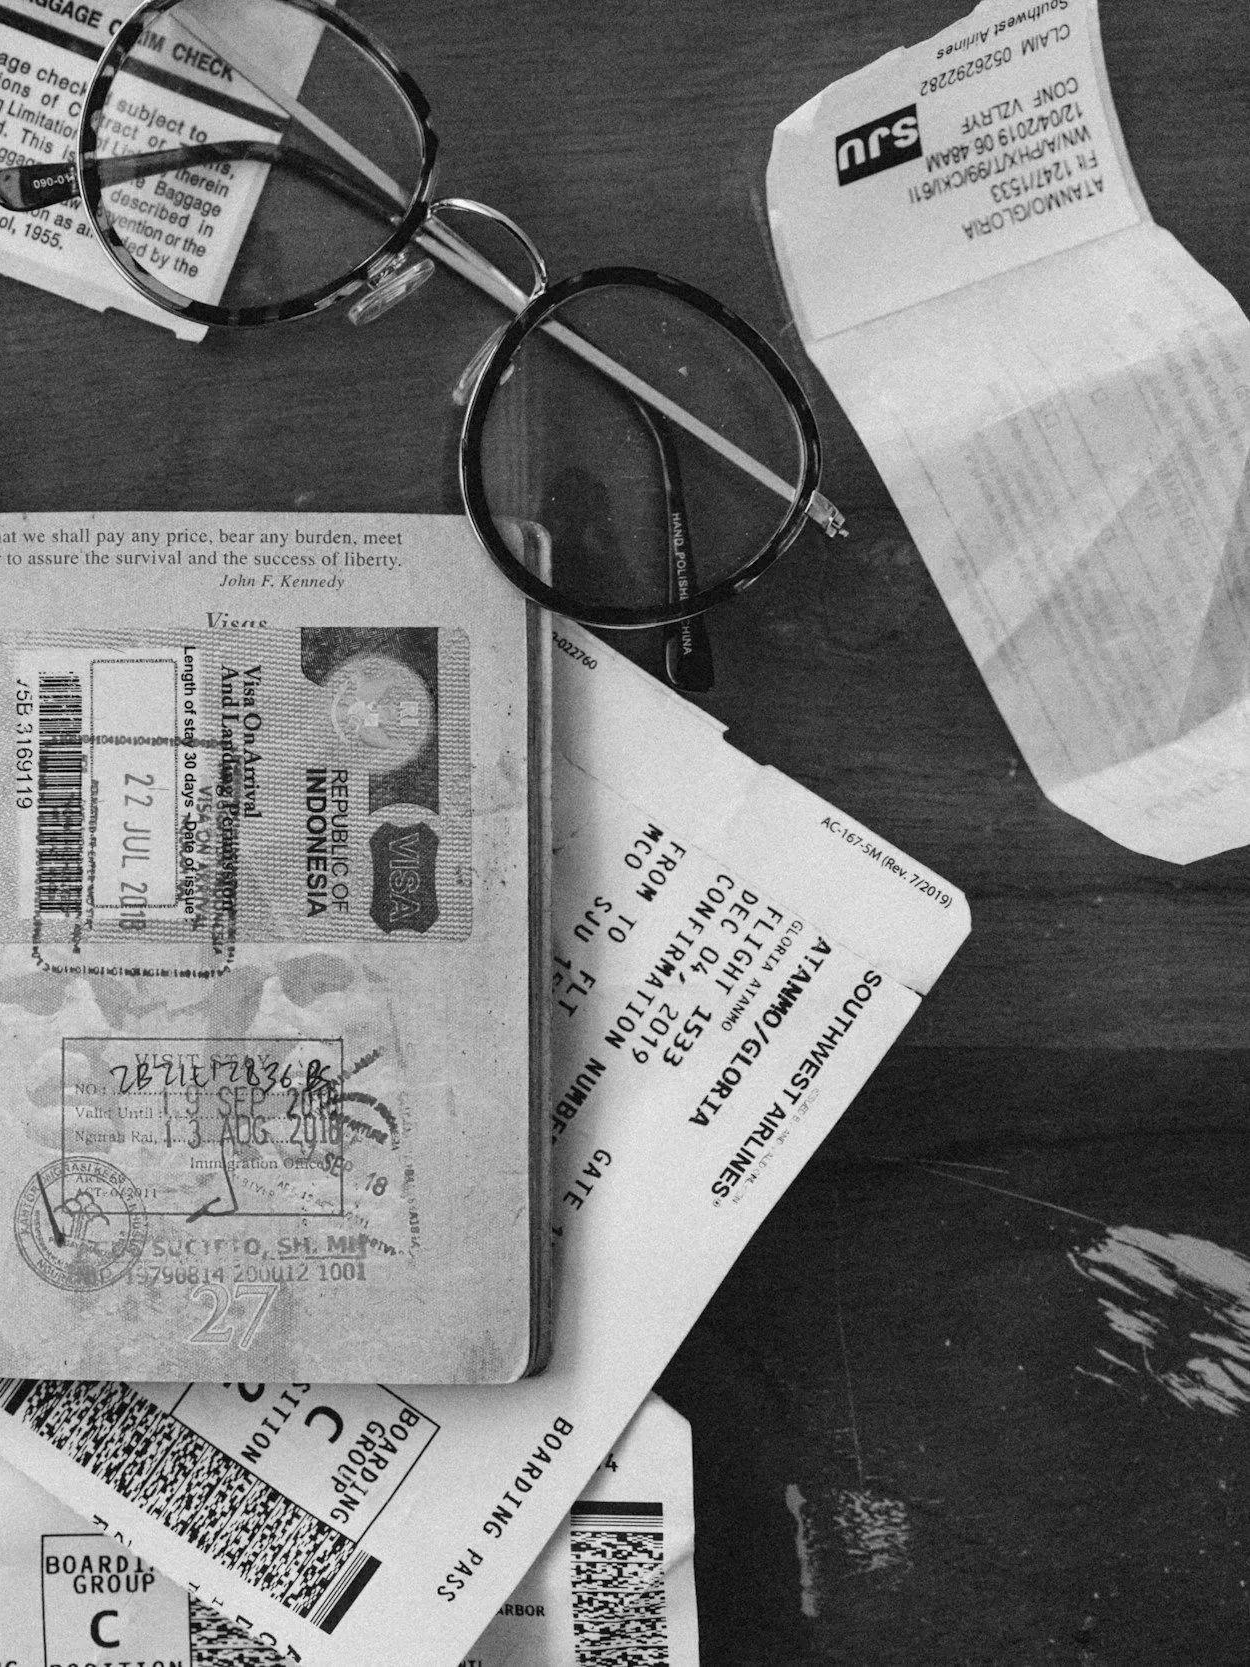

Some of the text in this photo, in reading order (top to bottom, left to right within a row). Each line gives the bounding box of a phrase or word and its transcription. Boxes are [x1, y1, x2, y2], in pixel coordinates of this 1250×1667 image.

[171, 42, 234, 83] CHECK
[919, 23, 1071, 97] CLAIM 0526292282
[935, 27, 990, 60] Airlines
[40, 91, 60, 109] of
[116, 96, 185, 136] subject
[188, 124, 208, 144] to
[960, 76, 1079, 135] CONF VZLRYF
[20, 128, 54, 154] This
[837, 115, 919, 170] SJU
[110, 188, 191, 229] described
[153, 180, 223, 218] Baggage
[174, 168, 230, 198] therein
[960, 175, 1104, 240] ATANMO/GLORIA
[23, 222, 64, 250] 1955.
[183, 238, 207, 258] the
[173, 258, 199, 278] the
[23, 532, 46, 544] we
[52, 528, 90, 544] shall
[96, 532, 125, 548] pay
[131, 532, 160, 548] any
[166, 529, 213, 547] price,
[219, 529, 253, 544] bear
[260, 532, 289, 548] any
[295, 530, 358, 547] burden,
[363, 532, 403, 545] meet
[671, 512, 685, 547] HAND
[7, 552, 22, 565] to
[27, 553, 79, 565] assure
[85, 550, 110, 565] the
[115, 550, 182, 565] survival
[188, 551, 217, 566] and
[223, 551, 248, 566] the
[253, 553, 316, 567] success
[321, 551, 339, 567] of
[344, 551, 403, 571] liberty.
[219, 574, 346, 591] John Kennedy
[215, 664, 240, 797] And Landing
[243, 664, 263, 819] Visa On Arrival
[181, 645, 197, 915] Length of stay 30 days Date issue
[121, 821, 152, 869] JUL
[306, 767, 328, 918] INDONESIA
[331, 769, 349, 915] REPUBLIC OF
[635, 840, 687, 903] FROM
[820, 816, 953, 909] AC-167-5M (Rev. 7/2019)
[388, 831, 420, 923] VISA
[572, 822, 665, 944] MCO SJU
[606, 914, 637, 945] TO
[603, 873, 736, 1050] CONFIRMATION
[631, 888, 760, 1065] DEC 2019
[661, 905, 784, 1068] FLIGHT 1533
[720, 919, 805, 1033] GLORIA ATANMO
[557, 969, 597, 1018] FLT
[687, 935, 834, 1129] ATANMO/GLORIA
[781, 968, 884, 1106] SOUTHWEST
[561, 1148, 613, 1212] GATE
[186, 1280, 281, 1351] 27
[303, 1404, 345, 1445] C
[329, 1420, 387, 1495] GROUP
[329, 1406, 421, 1525] BOARDING
[436, 1415, 575, 1603] BOARDING PASS
[72, 1573, 156, 1594] GROUP
[89, 1609, 121, 1648] C
